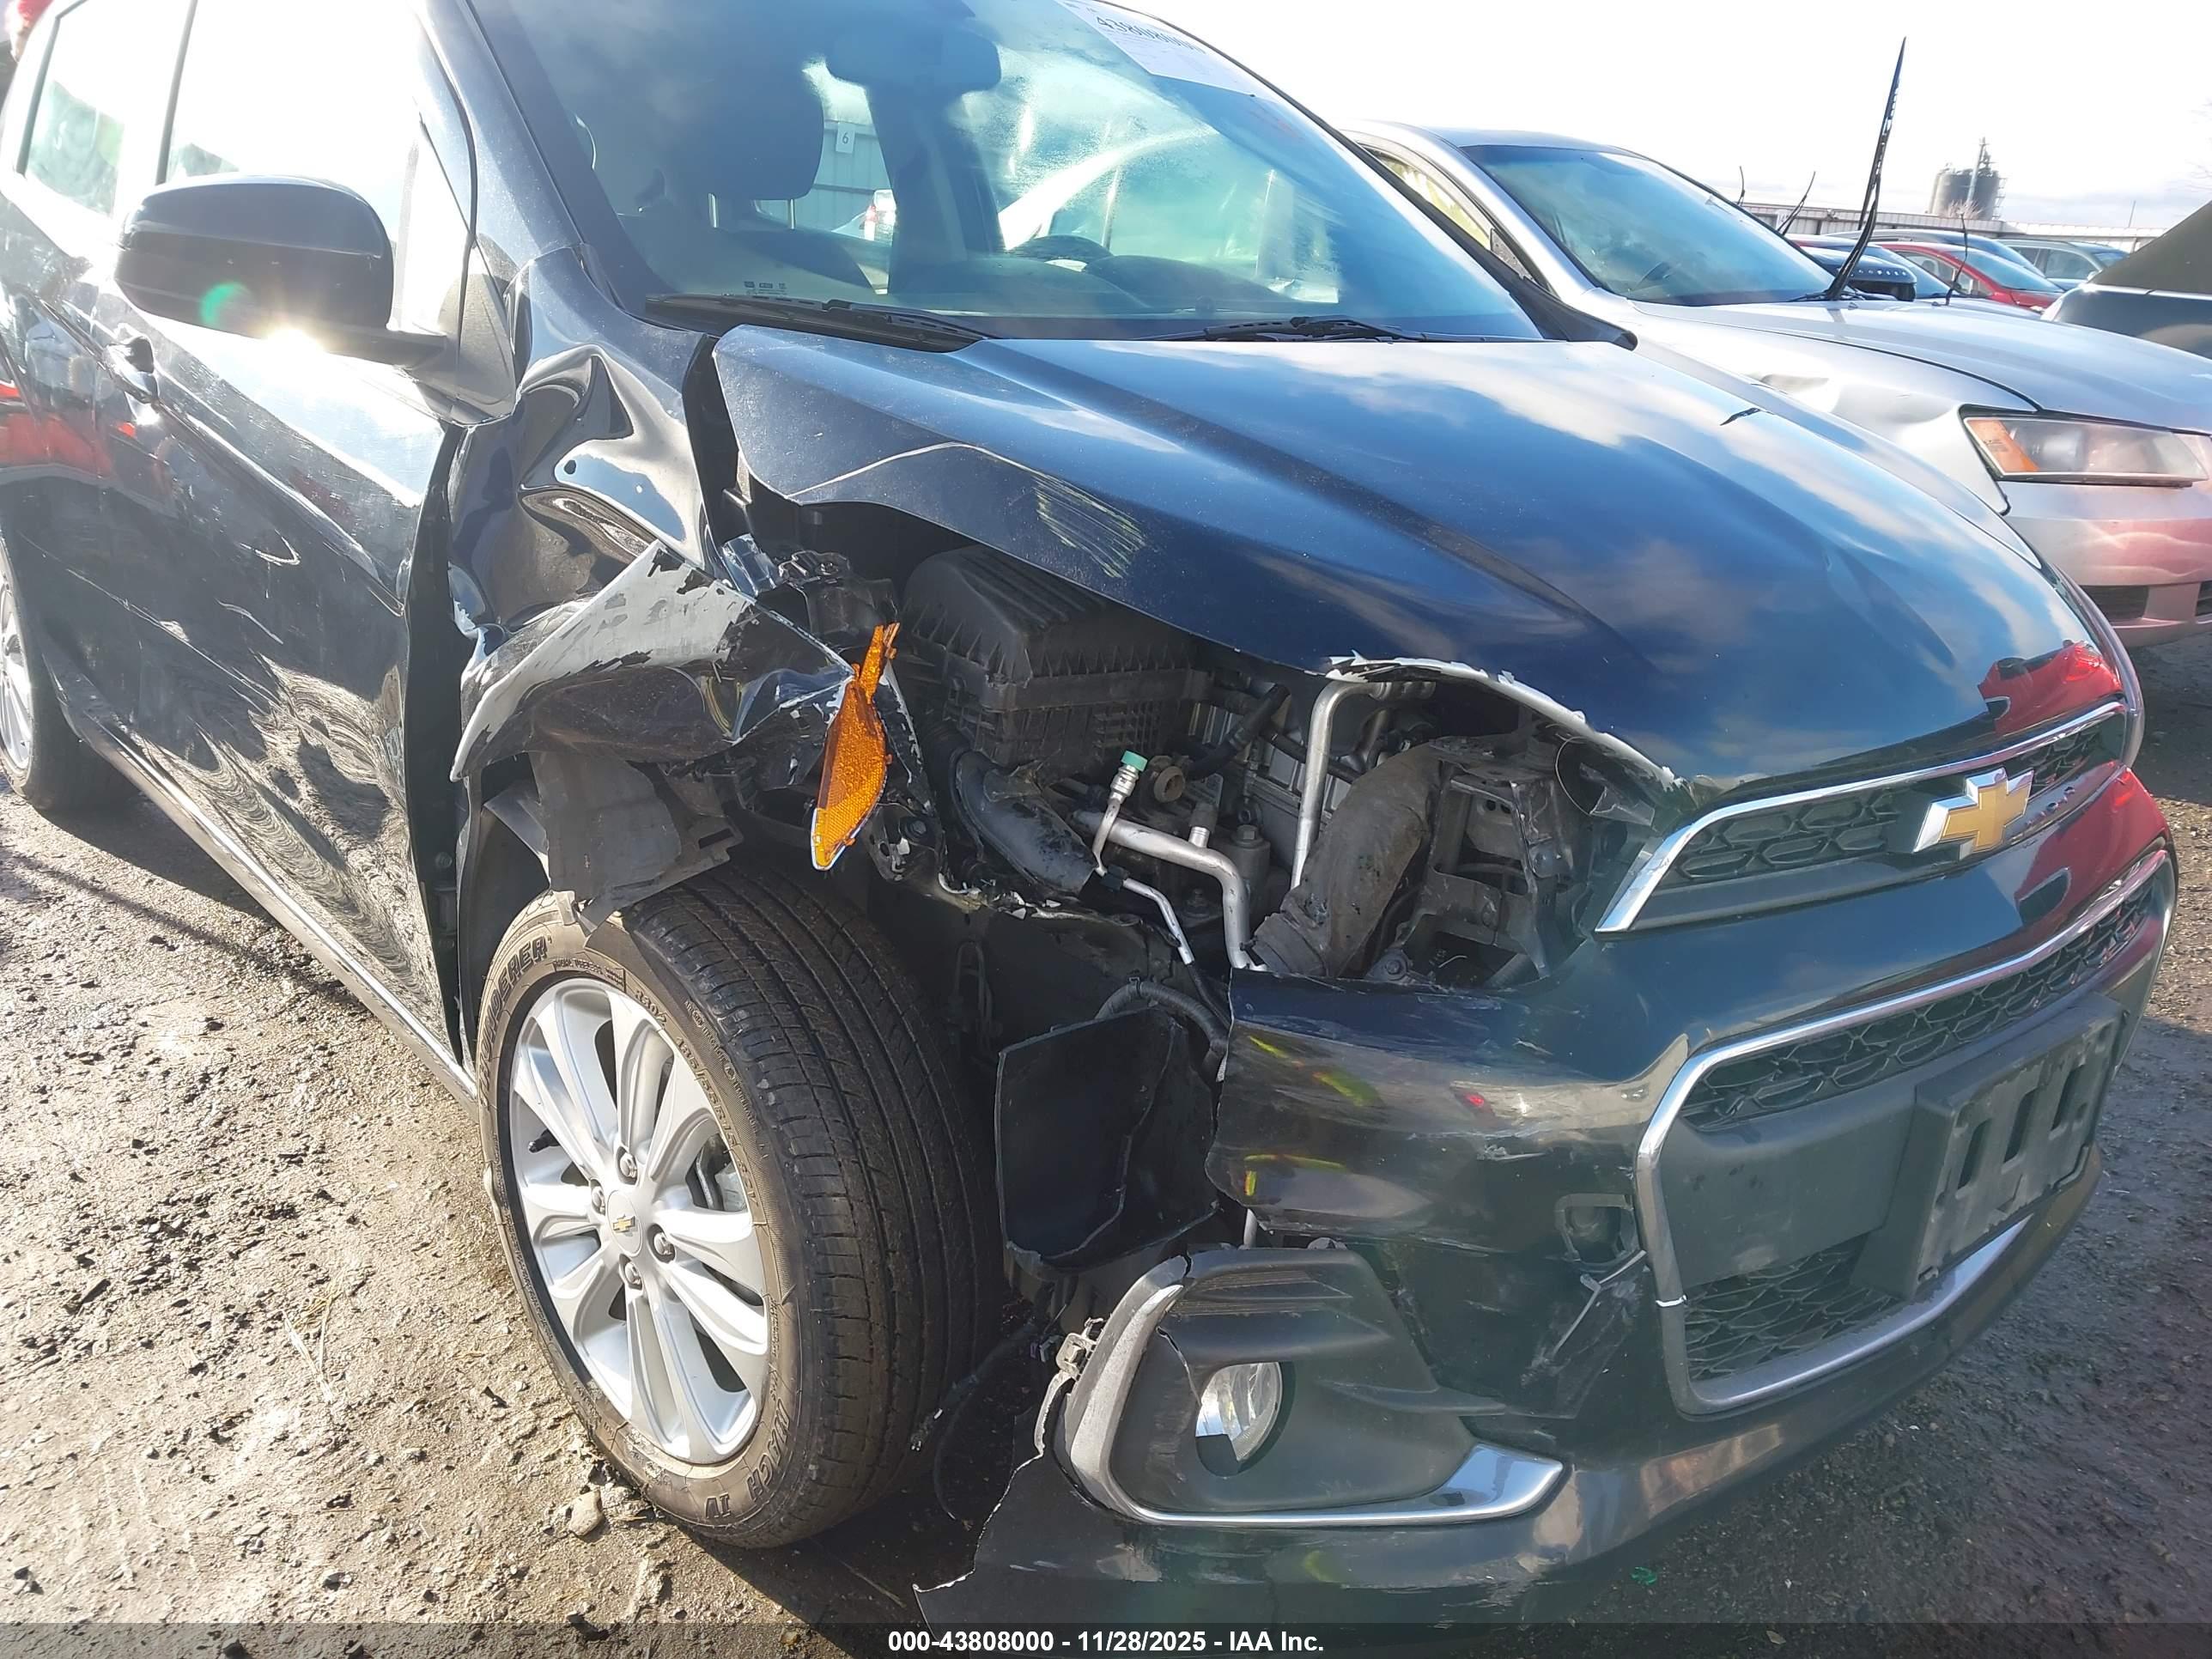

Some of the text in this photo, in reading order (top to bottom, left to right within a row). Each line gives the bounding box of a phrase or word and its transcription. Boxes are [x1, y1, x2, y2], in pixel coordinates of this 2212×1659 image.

[842, 131, 849, 144] 6
[745, 1397, 791, 1503] MACH
[704, 1493, 731, 1519] IV
